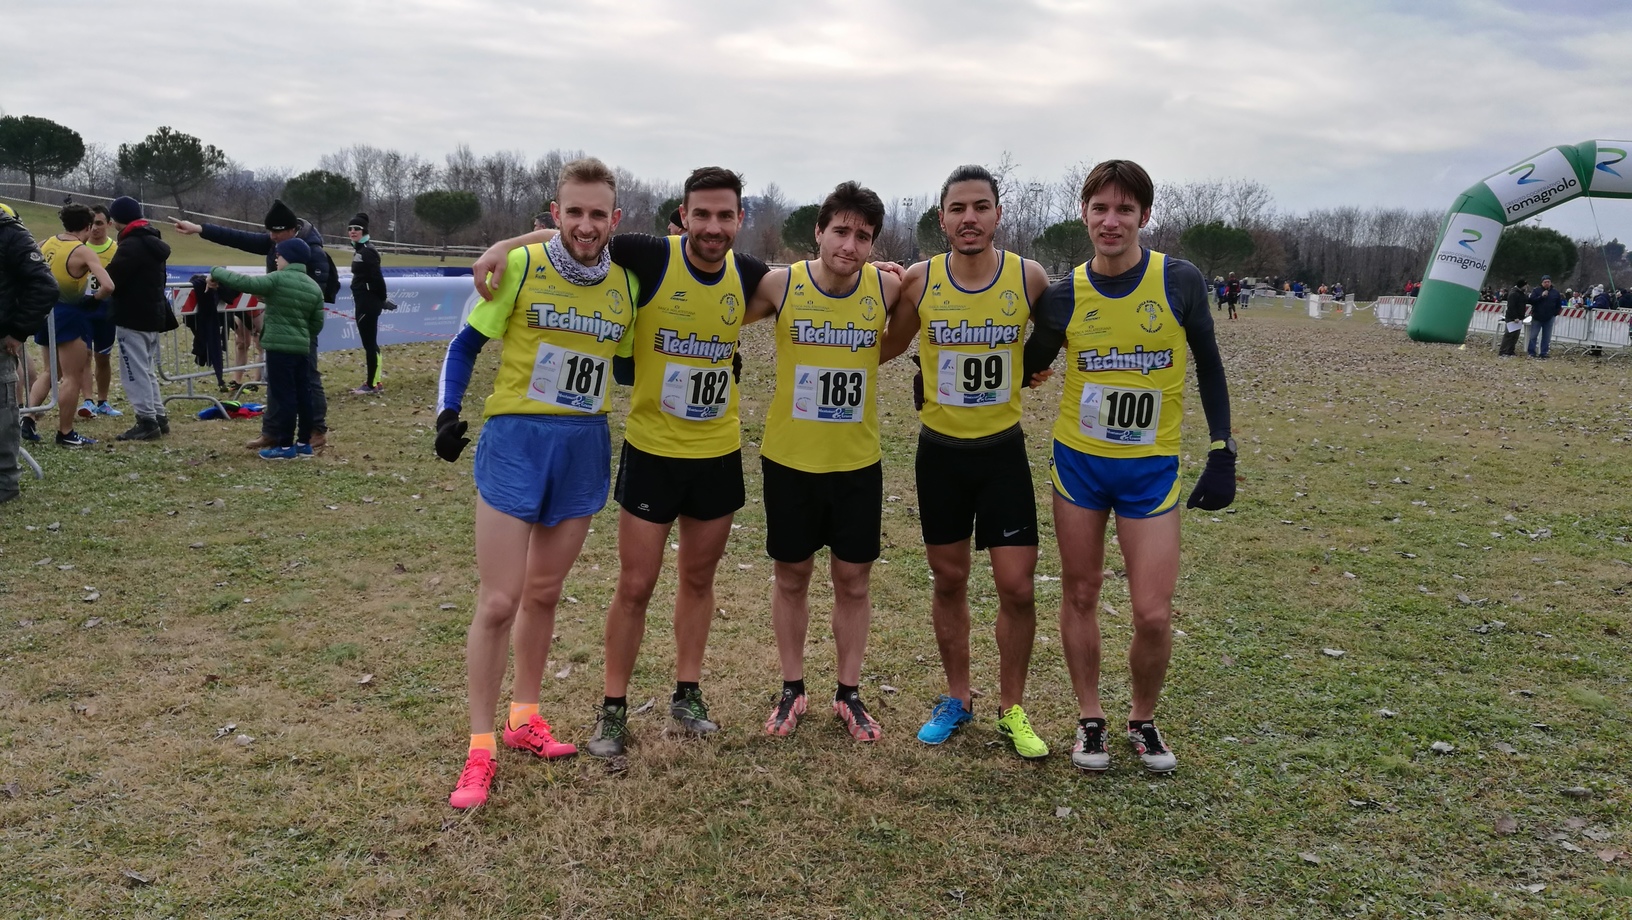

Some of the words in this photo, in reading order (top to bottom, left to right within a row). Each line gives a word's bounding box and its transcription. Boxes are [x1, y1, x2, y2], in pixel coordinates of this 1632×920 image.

[1506, 177, 1576, 214] romagnolo
[1437, 253, 1487, 271] romagnolo
[530, 303, 625, 342] Technipes
[793, 319, 878, 352] Technipes
[930, 318, 1020, 349] Technipes
[658, 328, 735, 363] Technipes
[1079, 345, 1172, 375] Technipes
[565, 355, 605, 397] 181
[690, 370, 729, 406] 182
[819, 371, 863, 407] 183
[963, 354, 1003, 392] 99
[1106, 391, 1155, 428] 100
